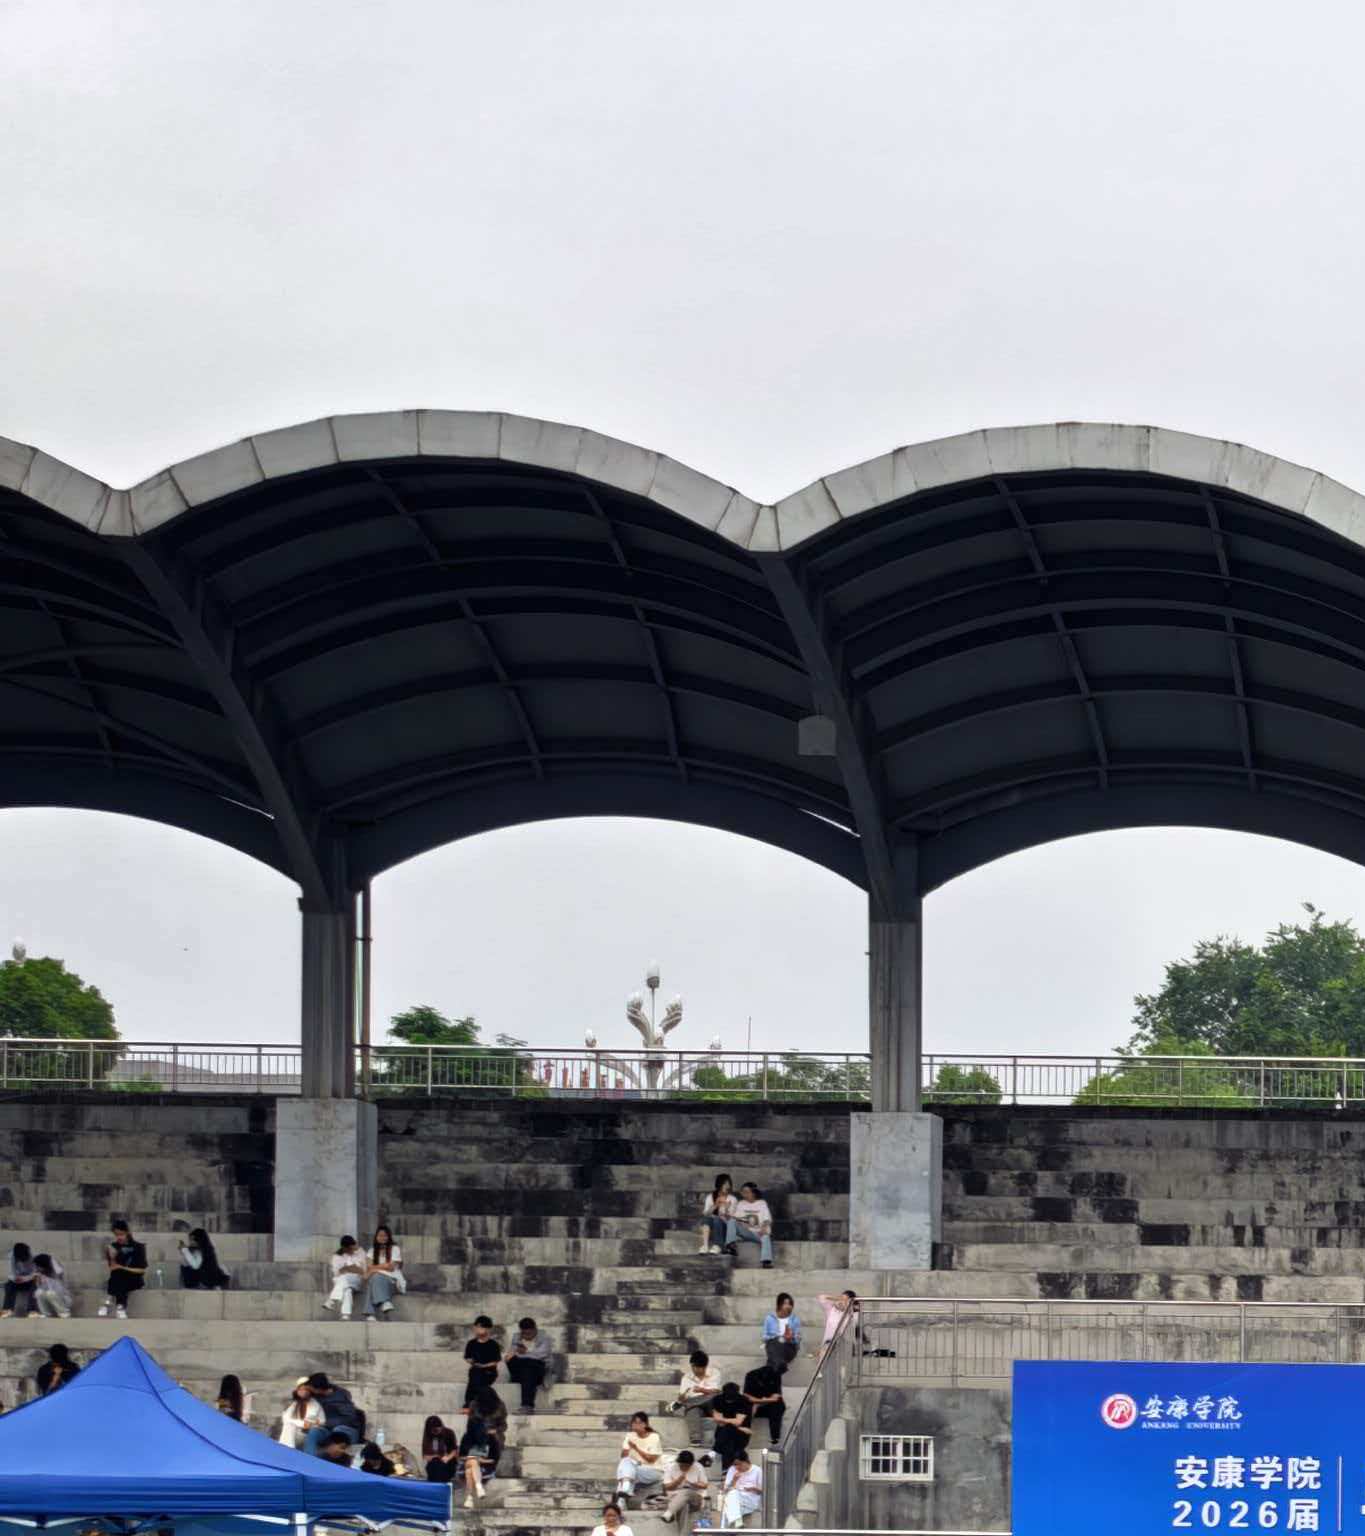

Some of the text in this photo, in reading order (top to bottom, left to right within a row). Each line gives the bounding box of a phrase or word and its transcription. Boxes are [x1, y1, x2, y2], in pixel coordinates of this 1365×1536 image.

[1140, 1395, 1242, 1420] 安康学院
[1174, 1455, 1321, 1490] 安康学院
[1172, 1498, 1319, 1531] 2026届
